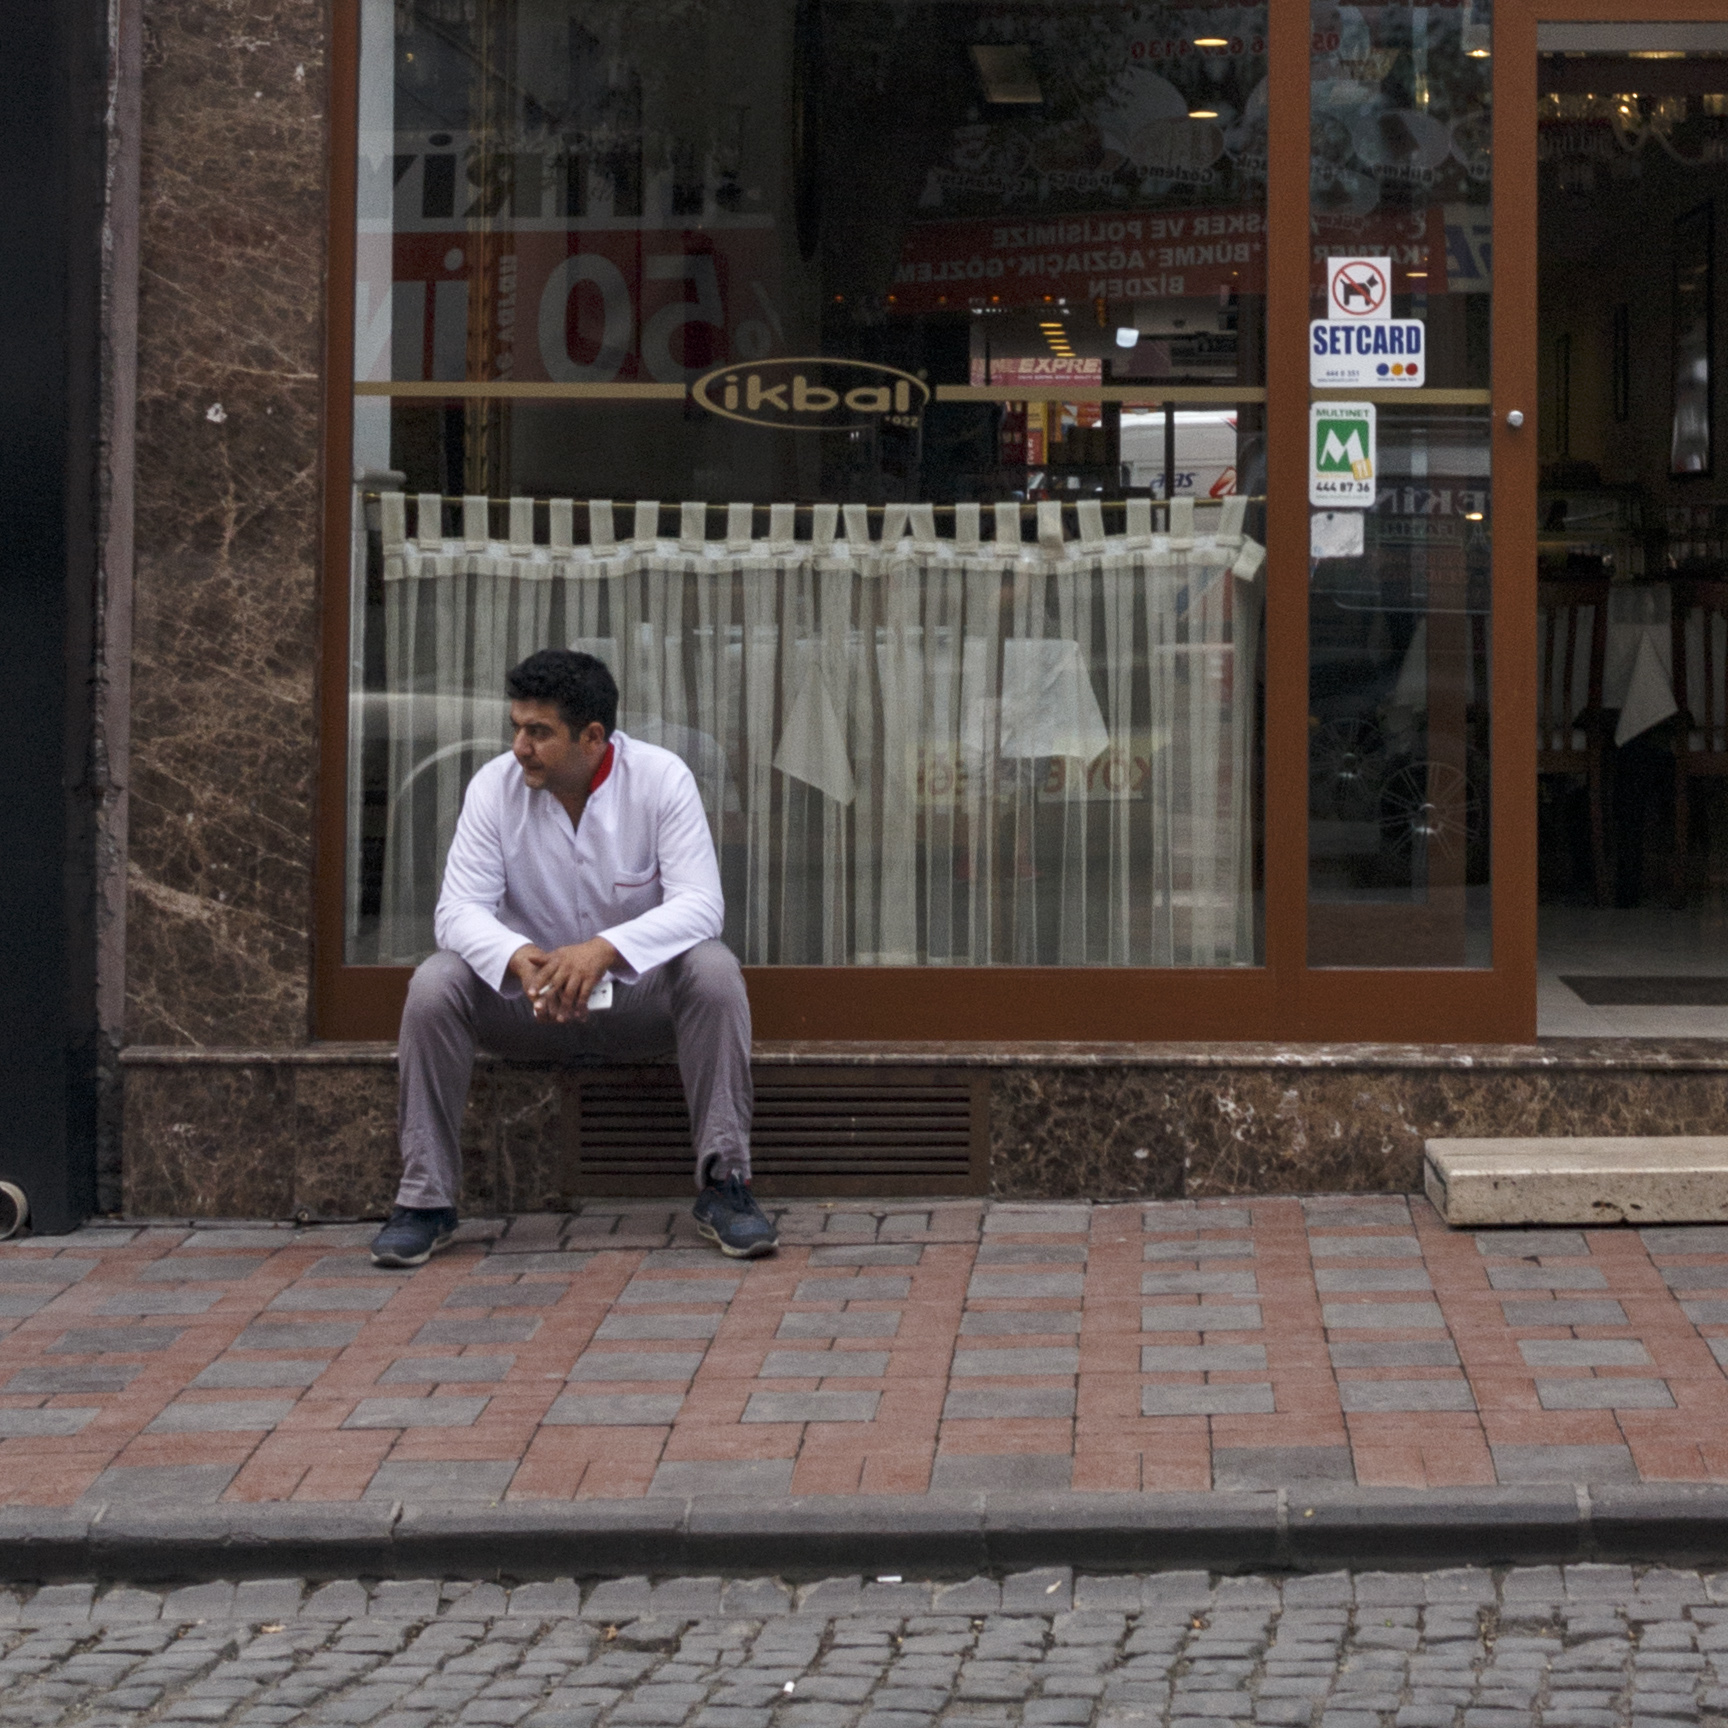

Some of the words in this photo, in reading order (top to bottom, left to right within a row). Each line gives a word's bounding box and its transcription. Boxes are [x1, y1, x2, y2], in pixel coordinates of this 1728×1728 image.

[1313, 325, 1421, 355] SETCARD
[1018, 357, 1102, 374] EXPRE
[724, 374, 910, 413] ikbal
[1316, 408, 1370, 418] MULTINET
[885, 415, 919, 428] 922
[1316, 482, 1337, 492] 444
[1357, 482, 1370, 492] 36
